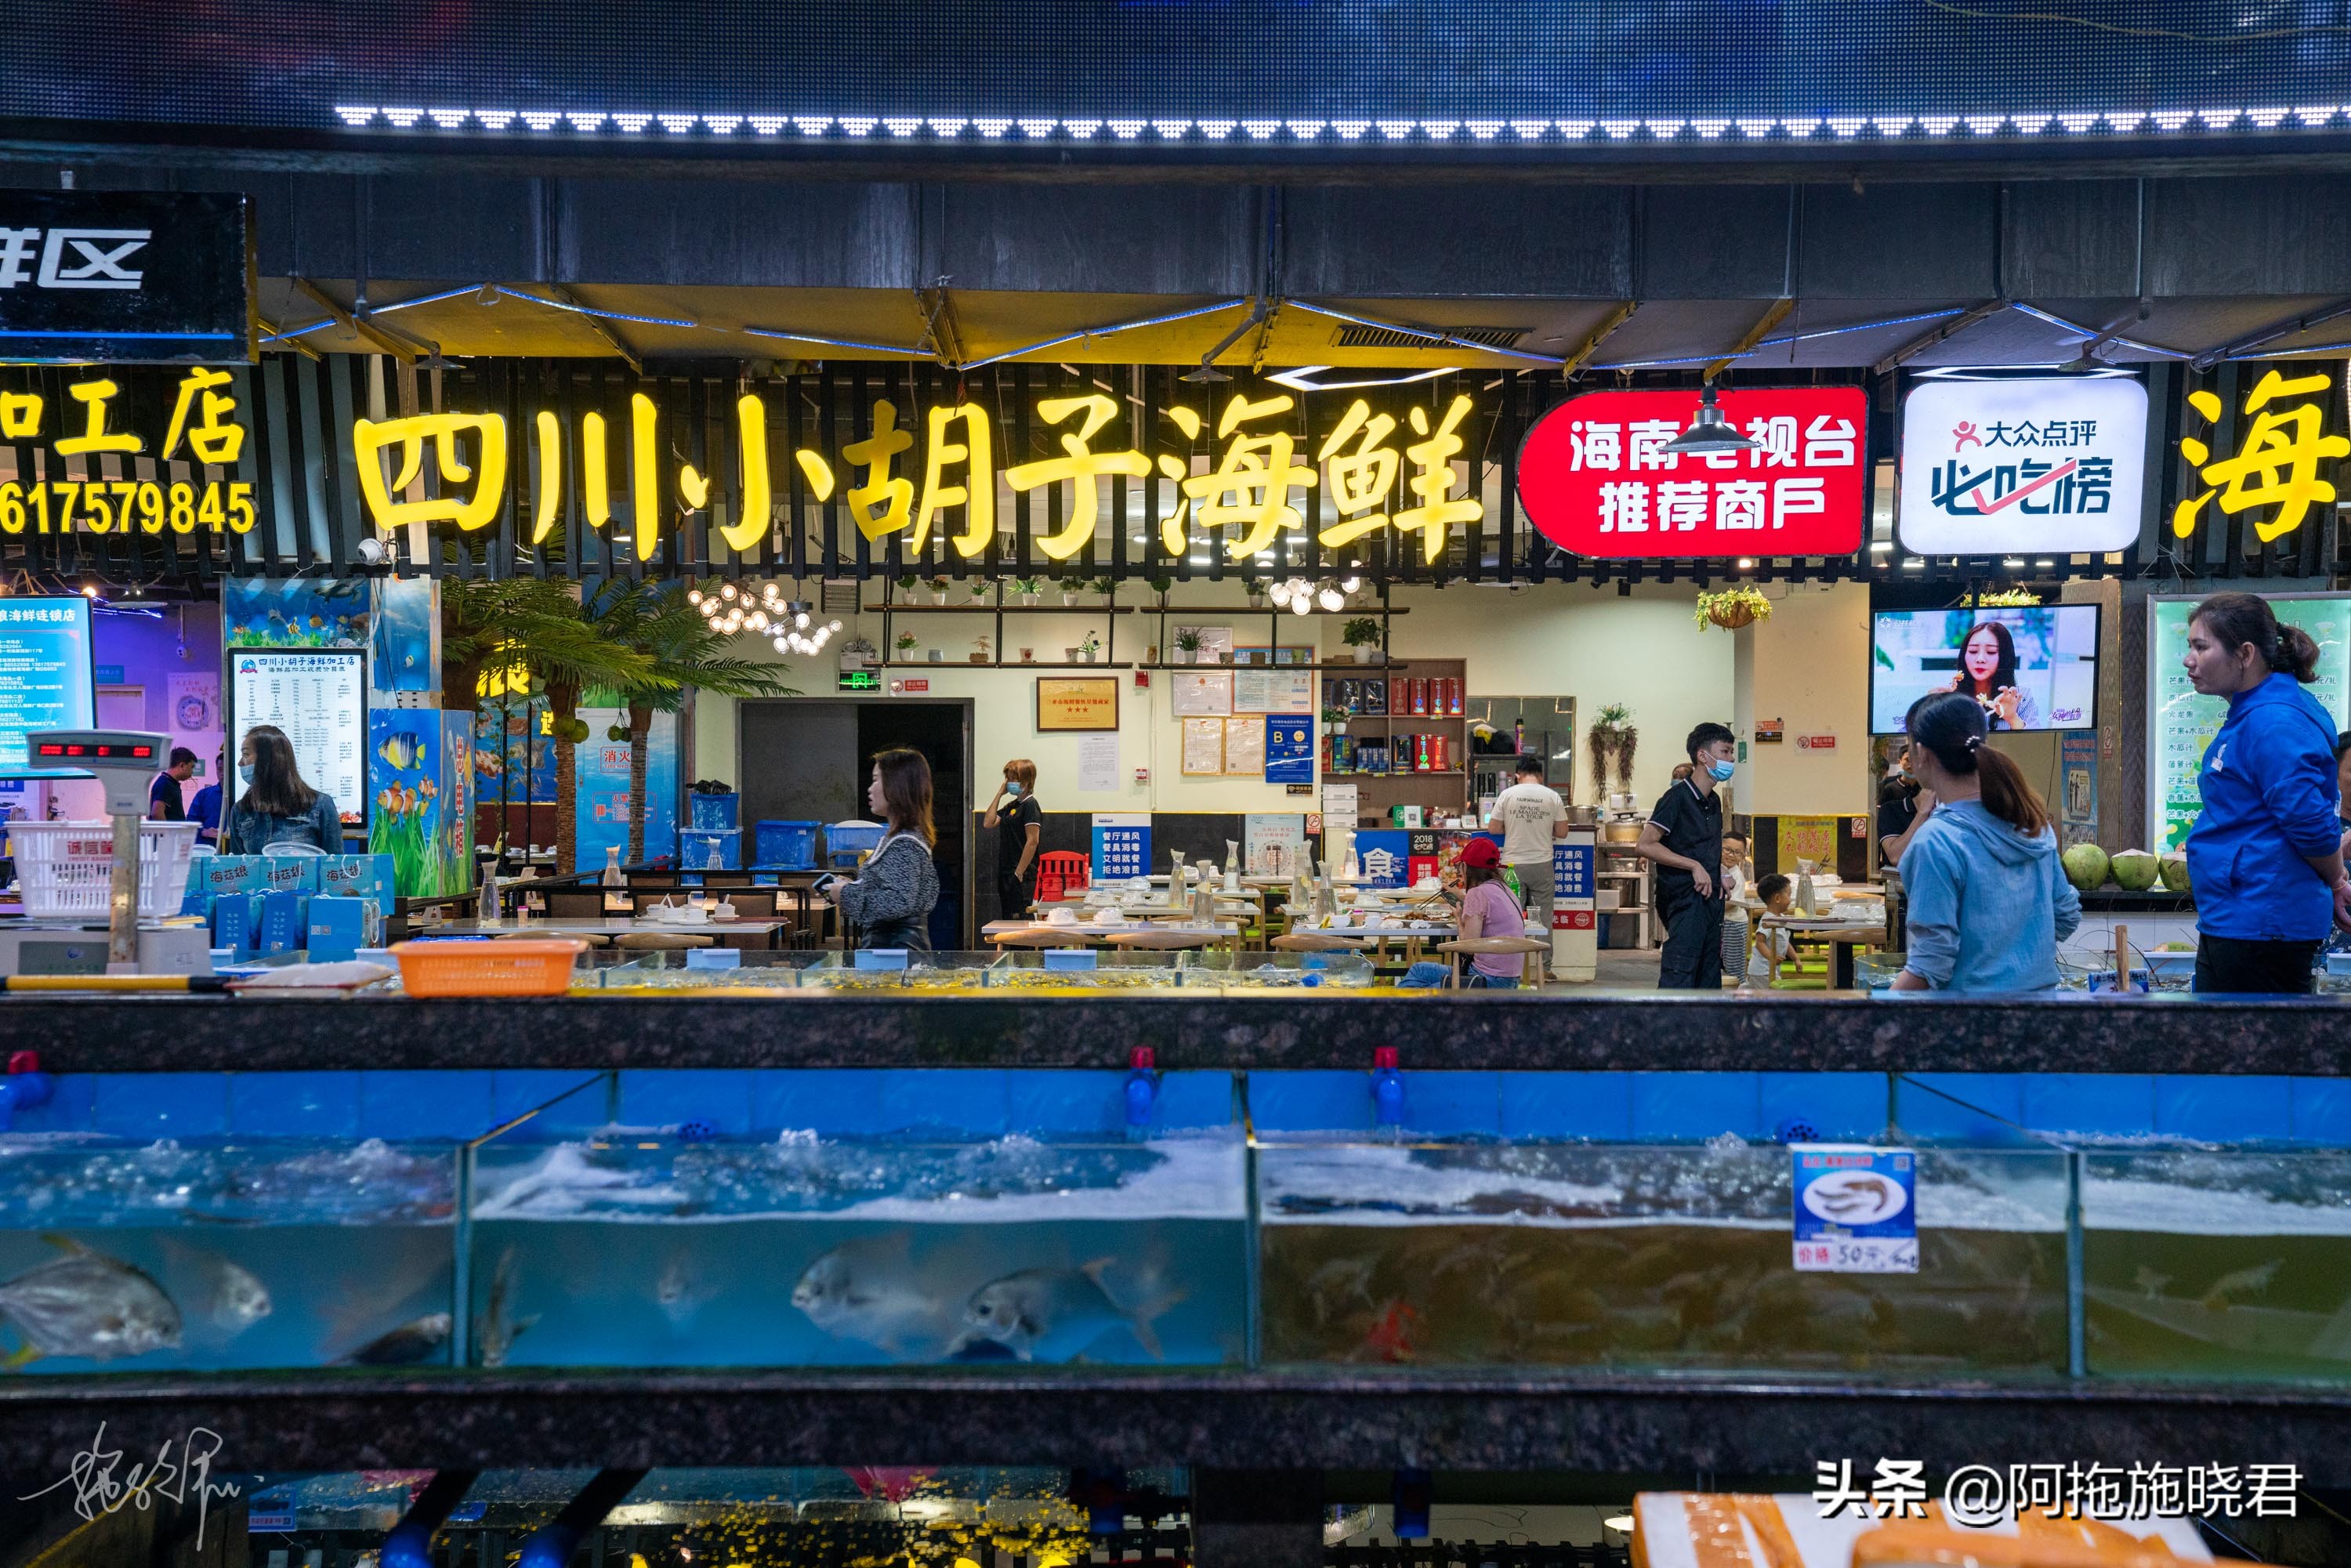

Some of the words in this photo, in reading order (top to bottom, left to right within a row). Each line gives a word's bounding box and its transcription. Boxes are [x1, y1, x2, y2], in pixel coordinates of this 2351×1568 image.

[1984, 419, 2097, 448] 大众点评
[2173, 370, 2351, 543] 海
[353, 393, 1483, 564] 四川小胡子海鲜
[1930, 456, 2114, 516] 必吃榜
[0, 482, 255, 535] 617579845
[1598, 476, 1826, 533] 推荐商户
[259, 656, 355, 666] 四川小胡子海鲜加工店
[2168, 810, 2203, 819] 芒果+火
[1103, 832, 1140, 841] 餐厅通风
[1103, 843, 1140, 852] 餐具消毒
[1103, 854, 1140, 864] 文明就餐
[1103, 865, 1140, 875] 拒绝浪费
